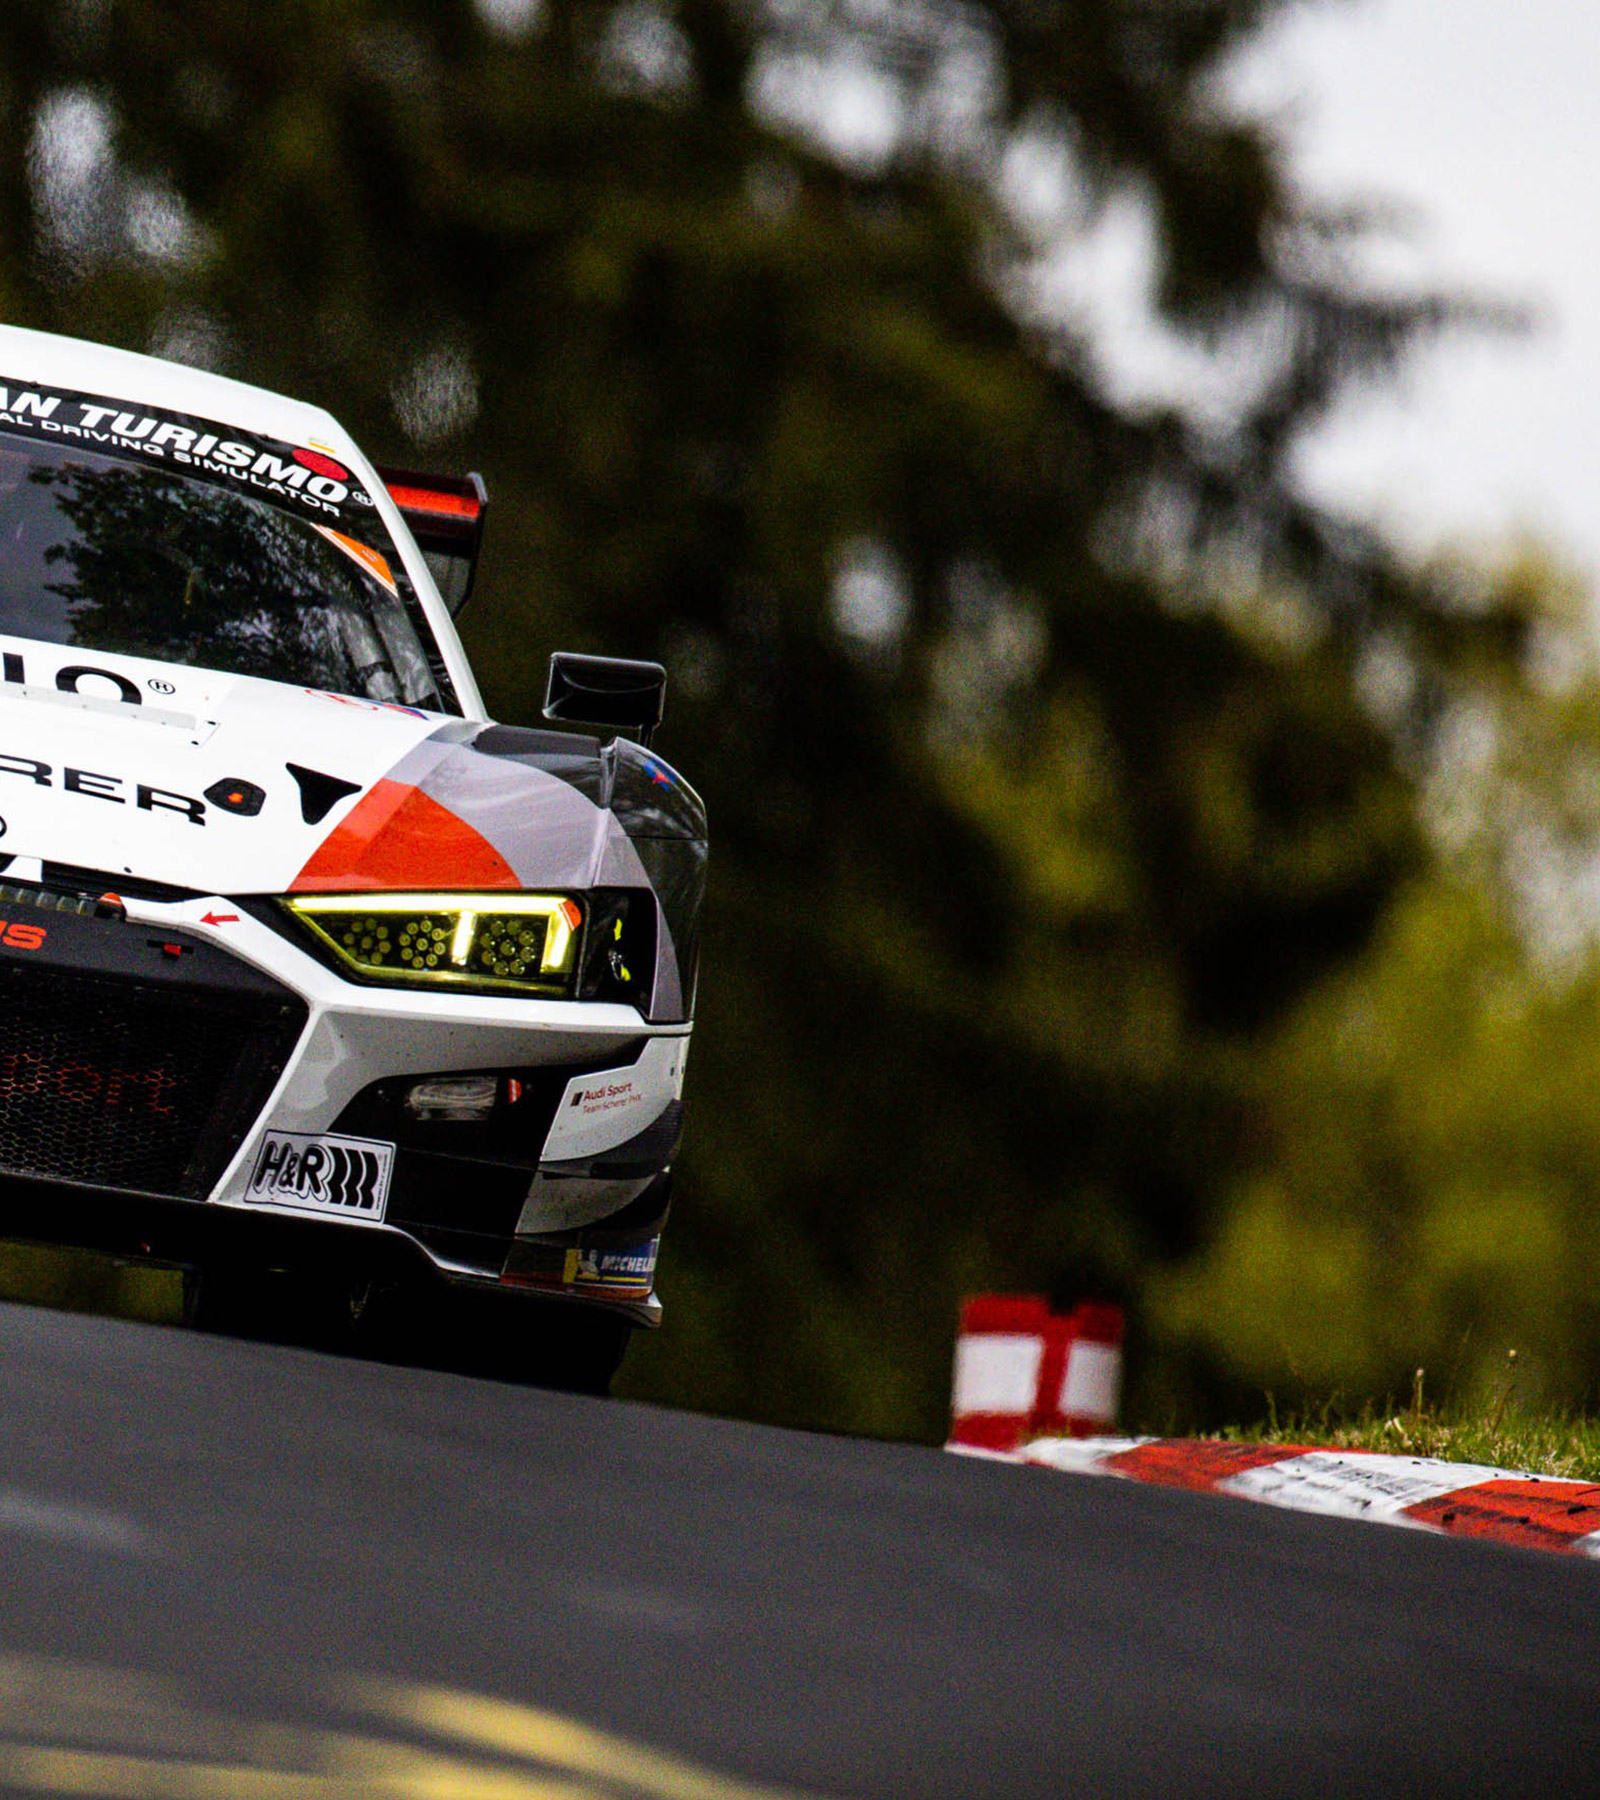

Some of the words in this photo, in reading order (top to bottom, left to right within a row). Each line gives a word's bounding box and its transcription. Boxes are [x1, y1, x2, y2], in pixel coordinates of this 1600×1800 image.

[41, 420, 165, 457] DRIVING
[173, 450, 341, 518] SIMULATOR
[584, 1087, 606, 1101] Audi
[607, 1082, 632, 1097] Sport
[253, 1141, 331, 1202] H&R
